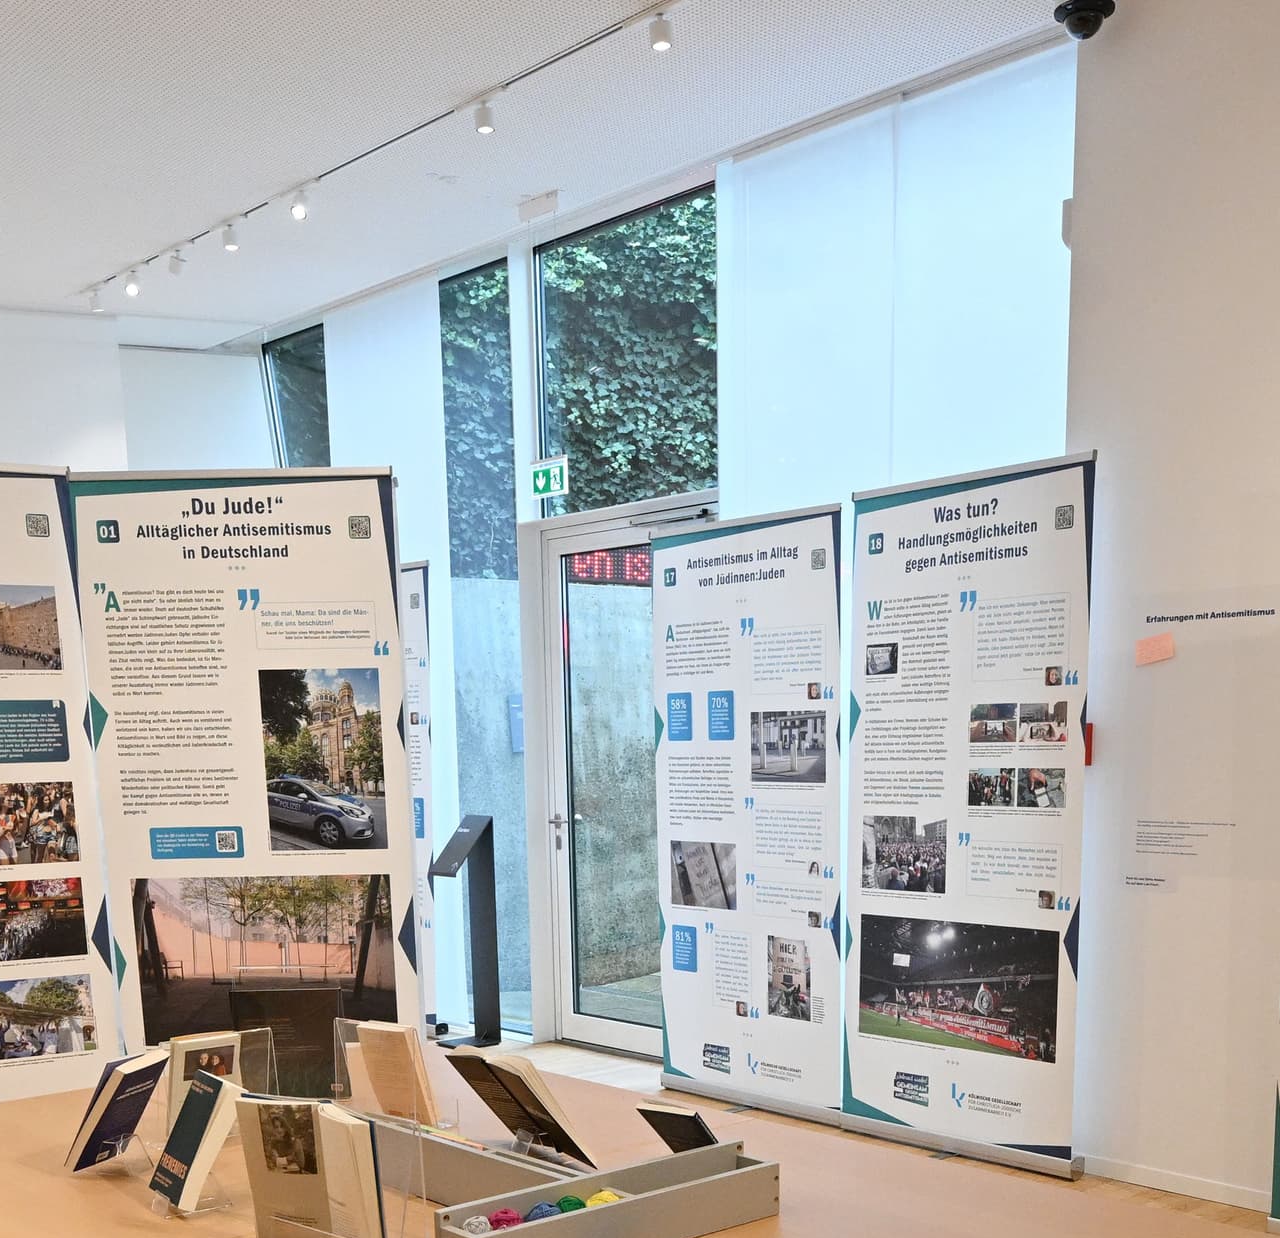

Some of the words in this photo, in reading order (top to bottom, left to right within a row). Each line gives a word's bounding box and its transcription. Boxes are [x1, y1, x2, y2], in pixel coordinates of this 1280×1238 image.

[933, 505, 961, 523] Was
[966, 497, 999, 519] tun?
[99, 524, 116, 539] 01
[136, 523, 219, 541] Alltäglicher
[222, 522, 332, 536] Antisemitismus
[898, 520, 1038, 550] Handlungsmöglichkeiten
[870, 534, 882, 550] 18
[182, 545, 195, 559] in
[200, 544, 289, 559] Deutschland
[686, 552, 754, 570] Antisemitismus
[756, 548, 768, 561] im
[769, 545, 799, 560] Alltag
[904, 556, 936, 573] gegen
[939, 545, 1028, 566] Antisemitismus
[698, 577, 713, 587] von
[715, 567, 785, 586] Jüdinnen:Juden
[260, 608, 279, 617] Schau
[280, 609, 295, 617] mal,
[317, 607, 327, 616] Da
[327, 608, 341, 616] sind
[353, 608, 369, 616] Män-
[1145, 614, 1194, 623] Erfahrungen
[1195, 612, 1209, 620] mit
[1209, 608, 1275, 619] Antisemitismus
[297, 618, 334, 626] beschützen!
[671, 699, 686, 710] 58%
[711, 697, 728, 709] 70%
[675, 930, 692, 942] 81%
